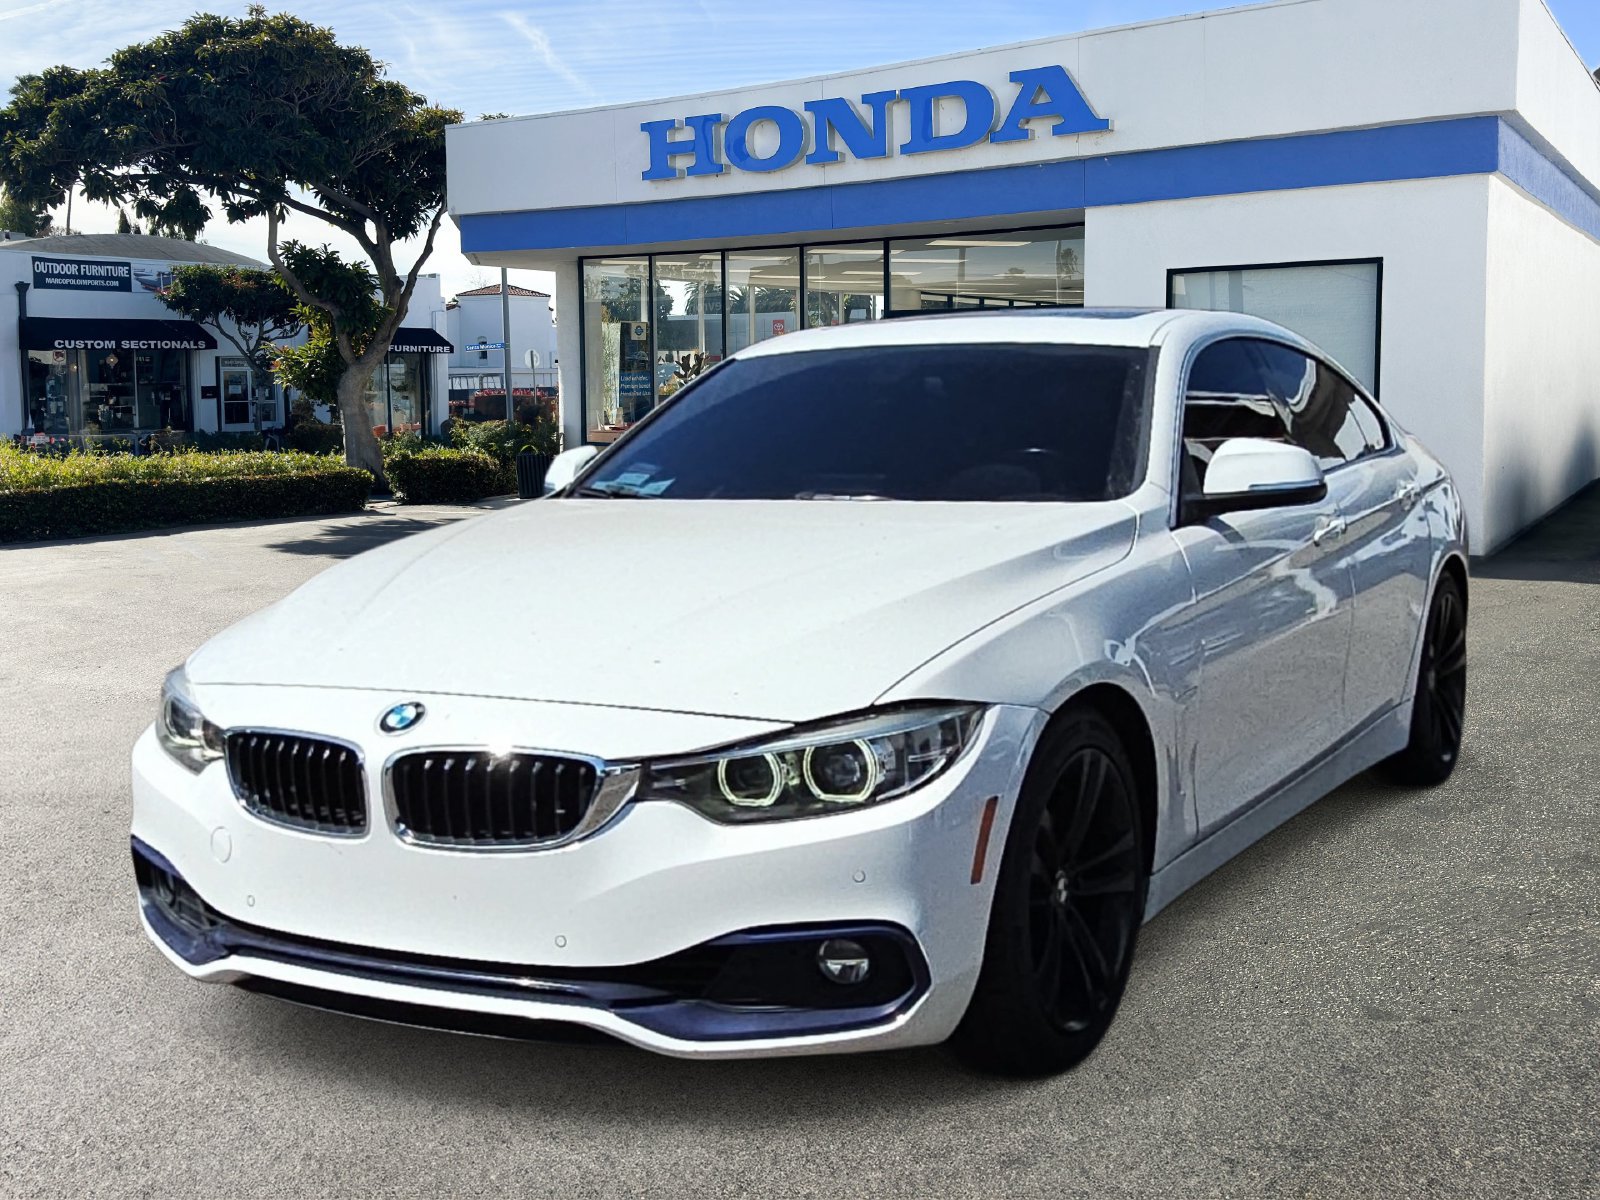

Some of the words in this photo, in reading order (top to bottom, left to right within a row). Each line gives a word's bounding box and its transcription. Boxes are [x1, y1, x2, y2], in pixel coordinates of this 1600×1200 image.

[641, 64, 1113, 182] HONDA
[34, 261, 78, 275] OUTDOOR
[80, 264, 130, 278] FURNITURE
[45, 277, 120, 287] MARCOPOLOIMPORTS.COM
[54, 339, 116, 349] CUSTOM
[121, 340, 206, 349] SECTIONALS
[388, 344, 451, 353] FURNITURE
